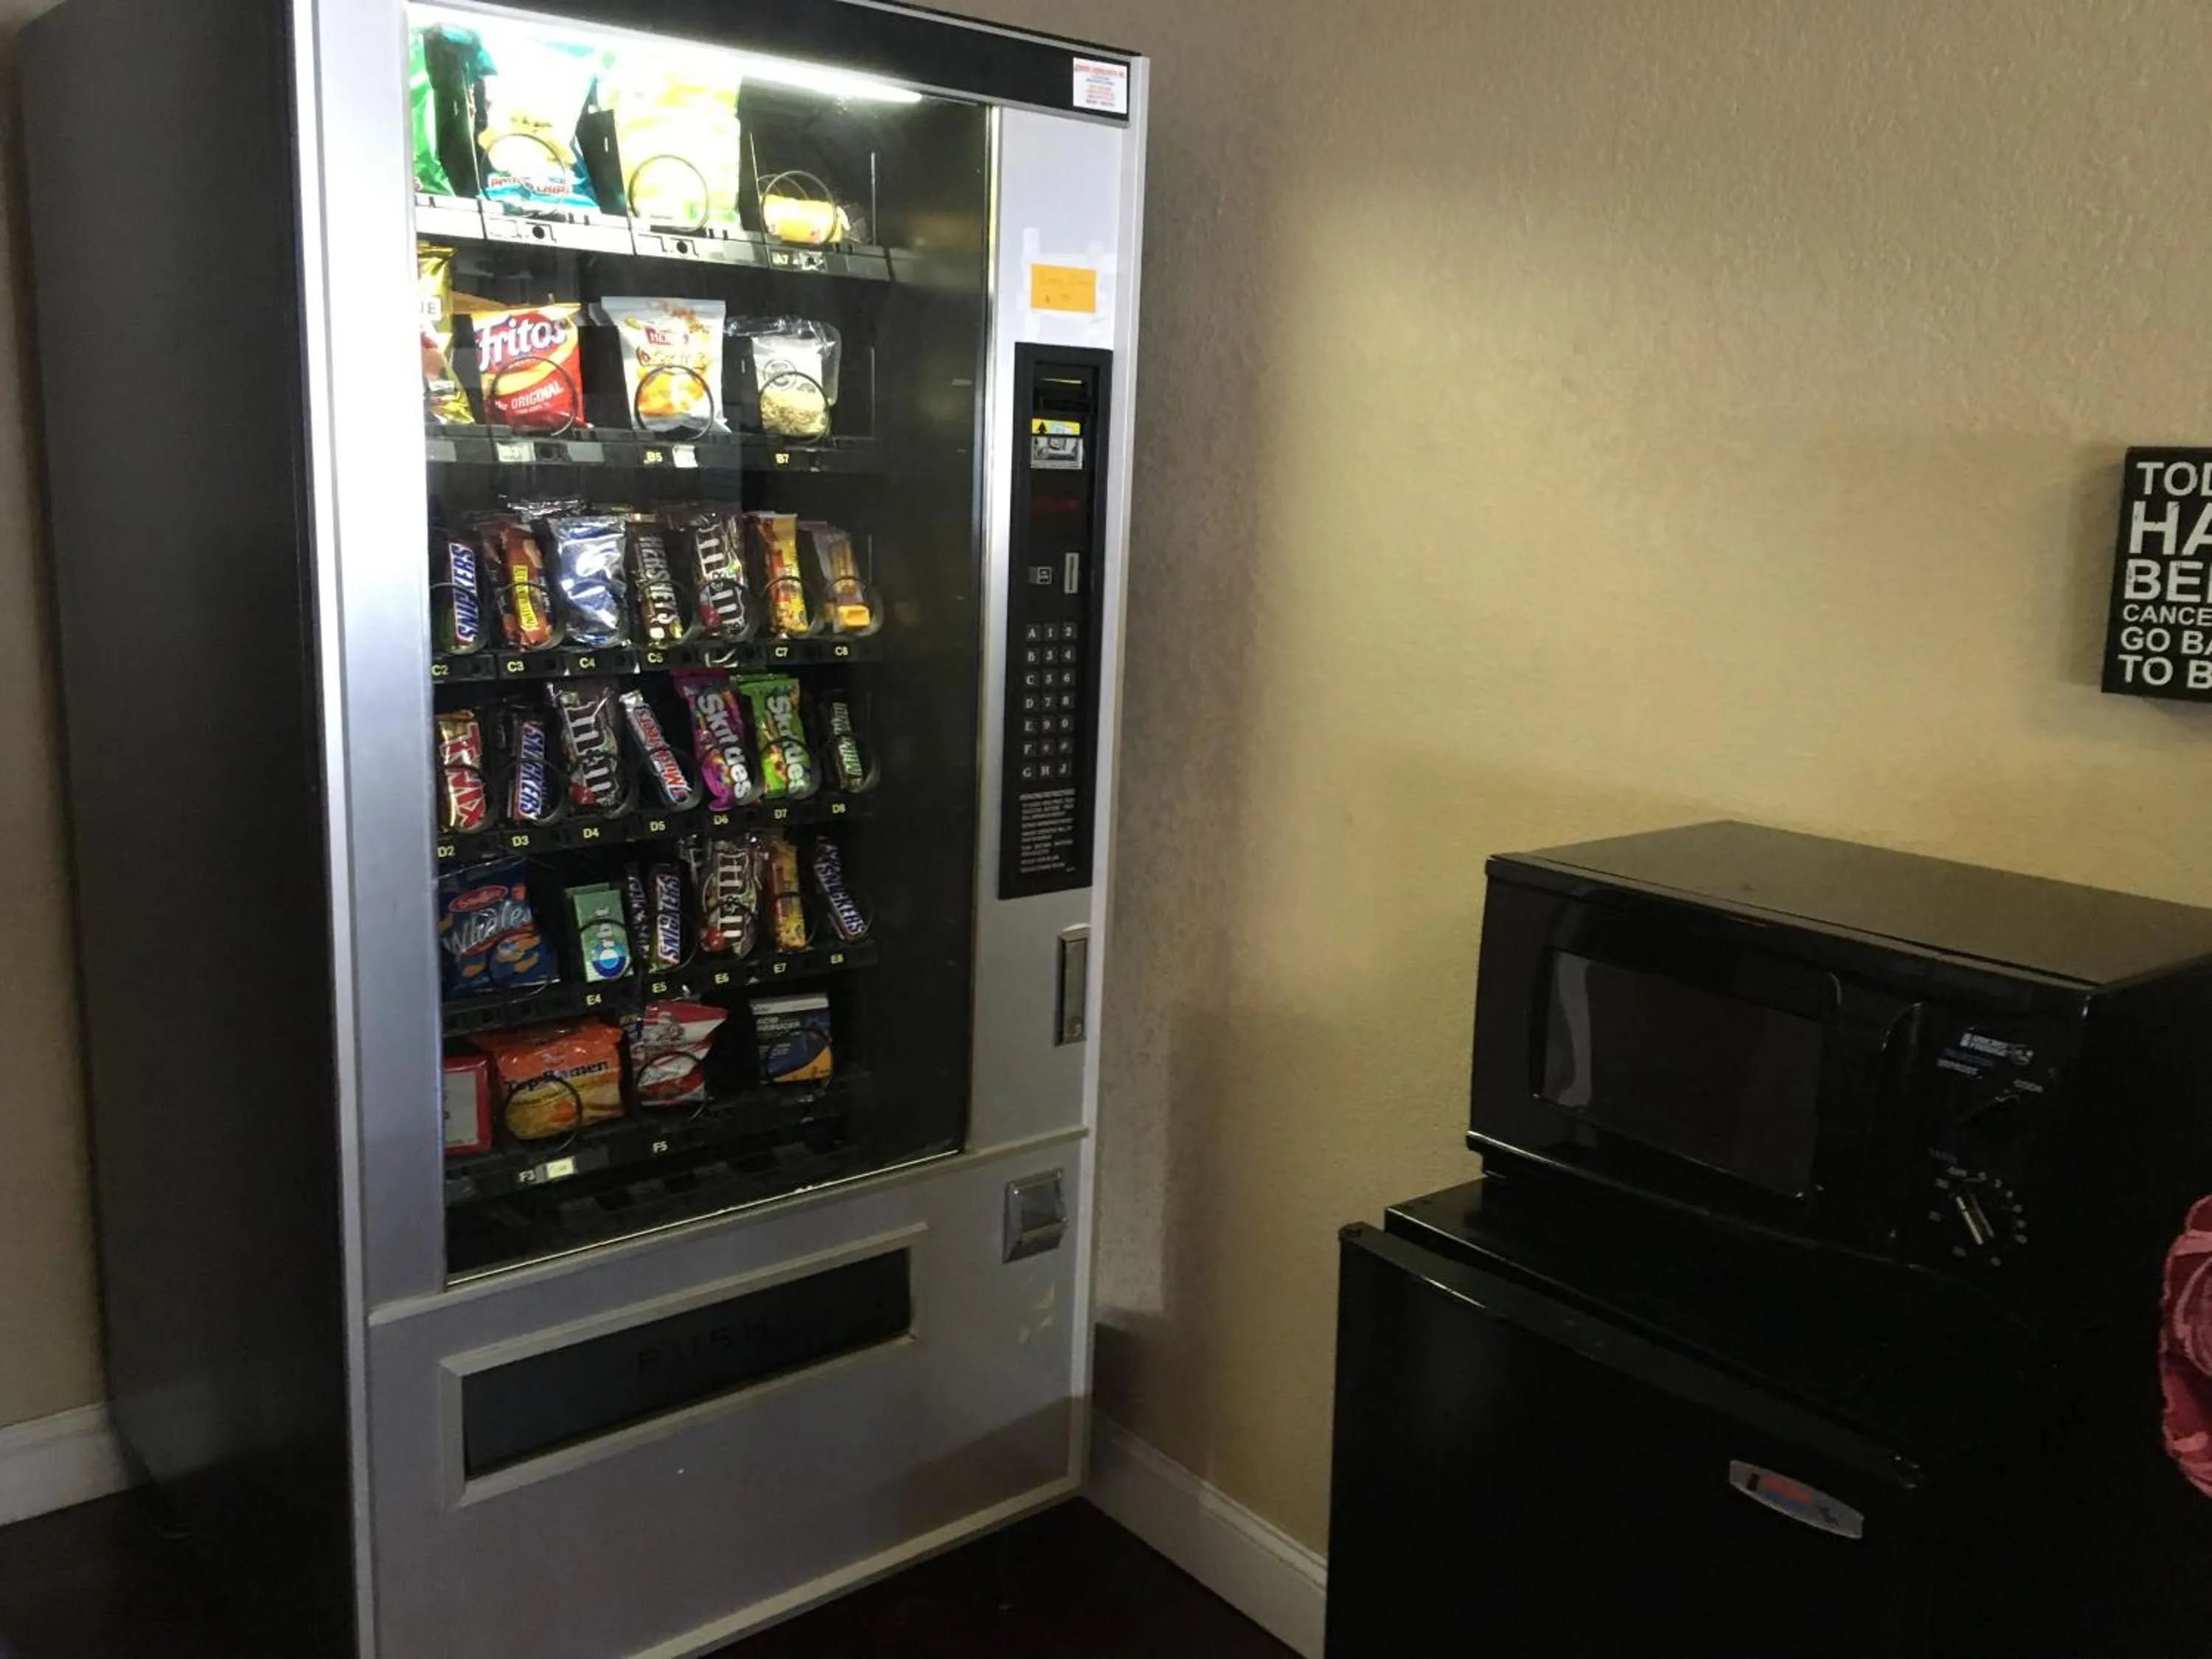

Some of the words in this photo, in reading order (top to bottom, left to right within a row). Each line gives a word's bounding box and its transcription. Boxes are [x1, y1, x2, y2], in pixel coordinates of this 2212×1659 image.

[476, 317, 568, 372] Fritos
[511, 381, 564, 409] ORIGINAL
[2124, 558, 2212, 603] BE
[2121, 626, 2171, 653] GO
[775, 647, 789, 657] C7
[507, 661, 524, 672] C3
[579, 657, 596, 668] C4
[431, 664, 449, 676] C2
[2118, 654, 2174, 686] TO
[1026, 675, 1035, 685] C
[713, 815, 729, 825] D6
[774, 809, 787, 819] D7
[650, 821, 666, 832] D5
[582, 827, 599, 839] D4
[512, 835, 529, 846] D3
[437, 846, 455, 858] D2
[653, 1141, 668, 1153] F5
